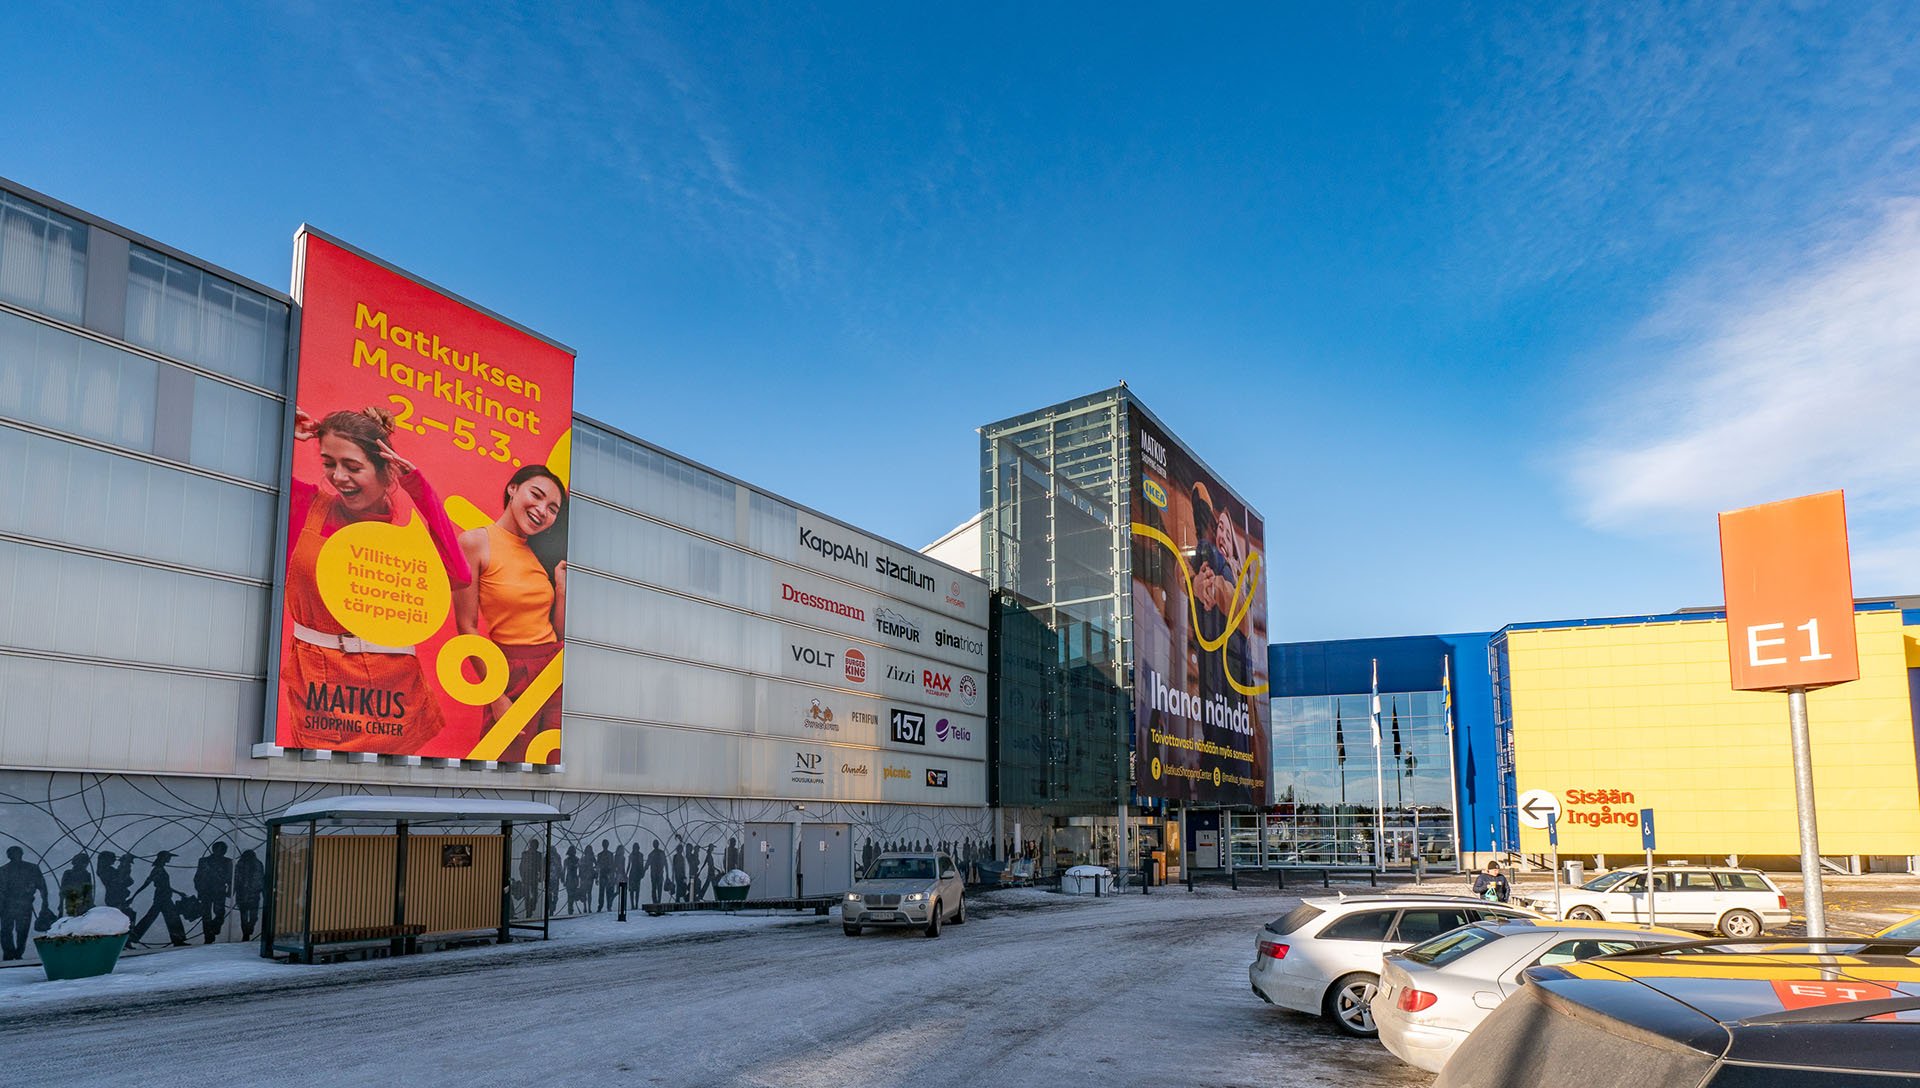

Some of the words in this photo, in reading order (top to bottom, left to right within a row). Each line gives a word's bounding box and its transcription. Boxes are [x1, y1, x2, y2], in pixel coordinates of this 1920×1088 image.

[355, 303, 541, 402] Matkuksen
[353, 339, 541, 435] Markkinat
[1141, 429, 1167, 467] MATKUS
[1145, 481, 1165, 505] IKEA
[350, 544, 427, 574] Villittyjä
[800, 527, 868, 568] KappAhl
[348, 562, 411, 587] hintoja
[416, 577, 428, 591] &
[875, 556, 935, 592] stadium
[350, 581, 424, 606] tuoreita
[782, 583, 865, 622] Dressmann
[343, 598, 428, 624] tärppejä!
[876, 619, 920, 643] TEMPUR
[1746, 618, 1833, 668] E1
[791, 645, 835, 668] VOLT
[845, 657, 866, 668] BURGER
[845, 664, 866, 677] KING
[887, 664, 915, 684] Zizzi
[923, 669, 952, 693] RAX
[306, 681, 405, 719] MATKUS
[1151, 670, 1201, 721] Ihana
[1205, 693, 1254, 736] nähdä.
[305, 715, 362, 733] SHOPPING
[366, 721, 403, 736] CENTER
[852, 711, 879, 725] PETRIFUN
[951, 725, 971, 741] Telia
[1151, 728, 1194, 749] Toivottavasti
[1219, 745, 1233, 759] myös
[796, 752, 822, 770] NP
[841, 763, 868, 775] Arnolds
[883, 765, 912, 780] picnic
[1566, 789, 1635, 804] Sisään
[1567, 805, 1638, 828] Ingång
